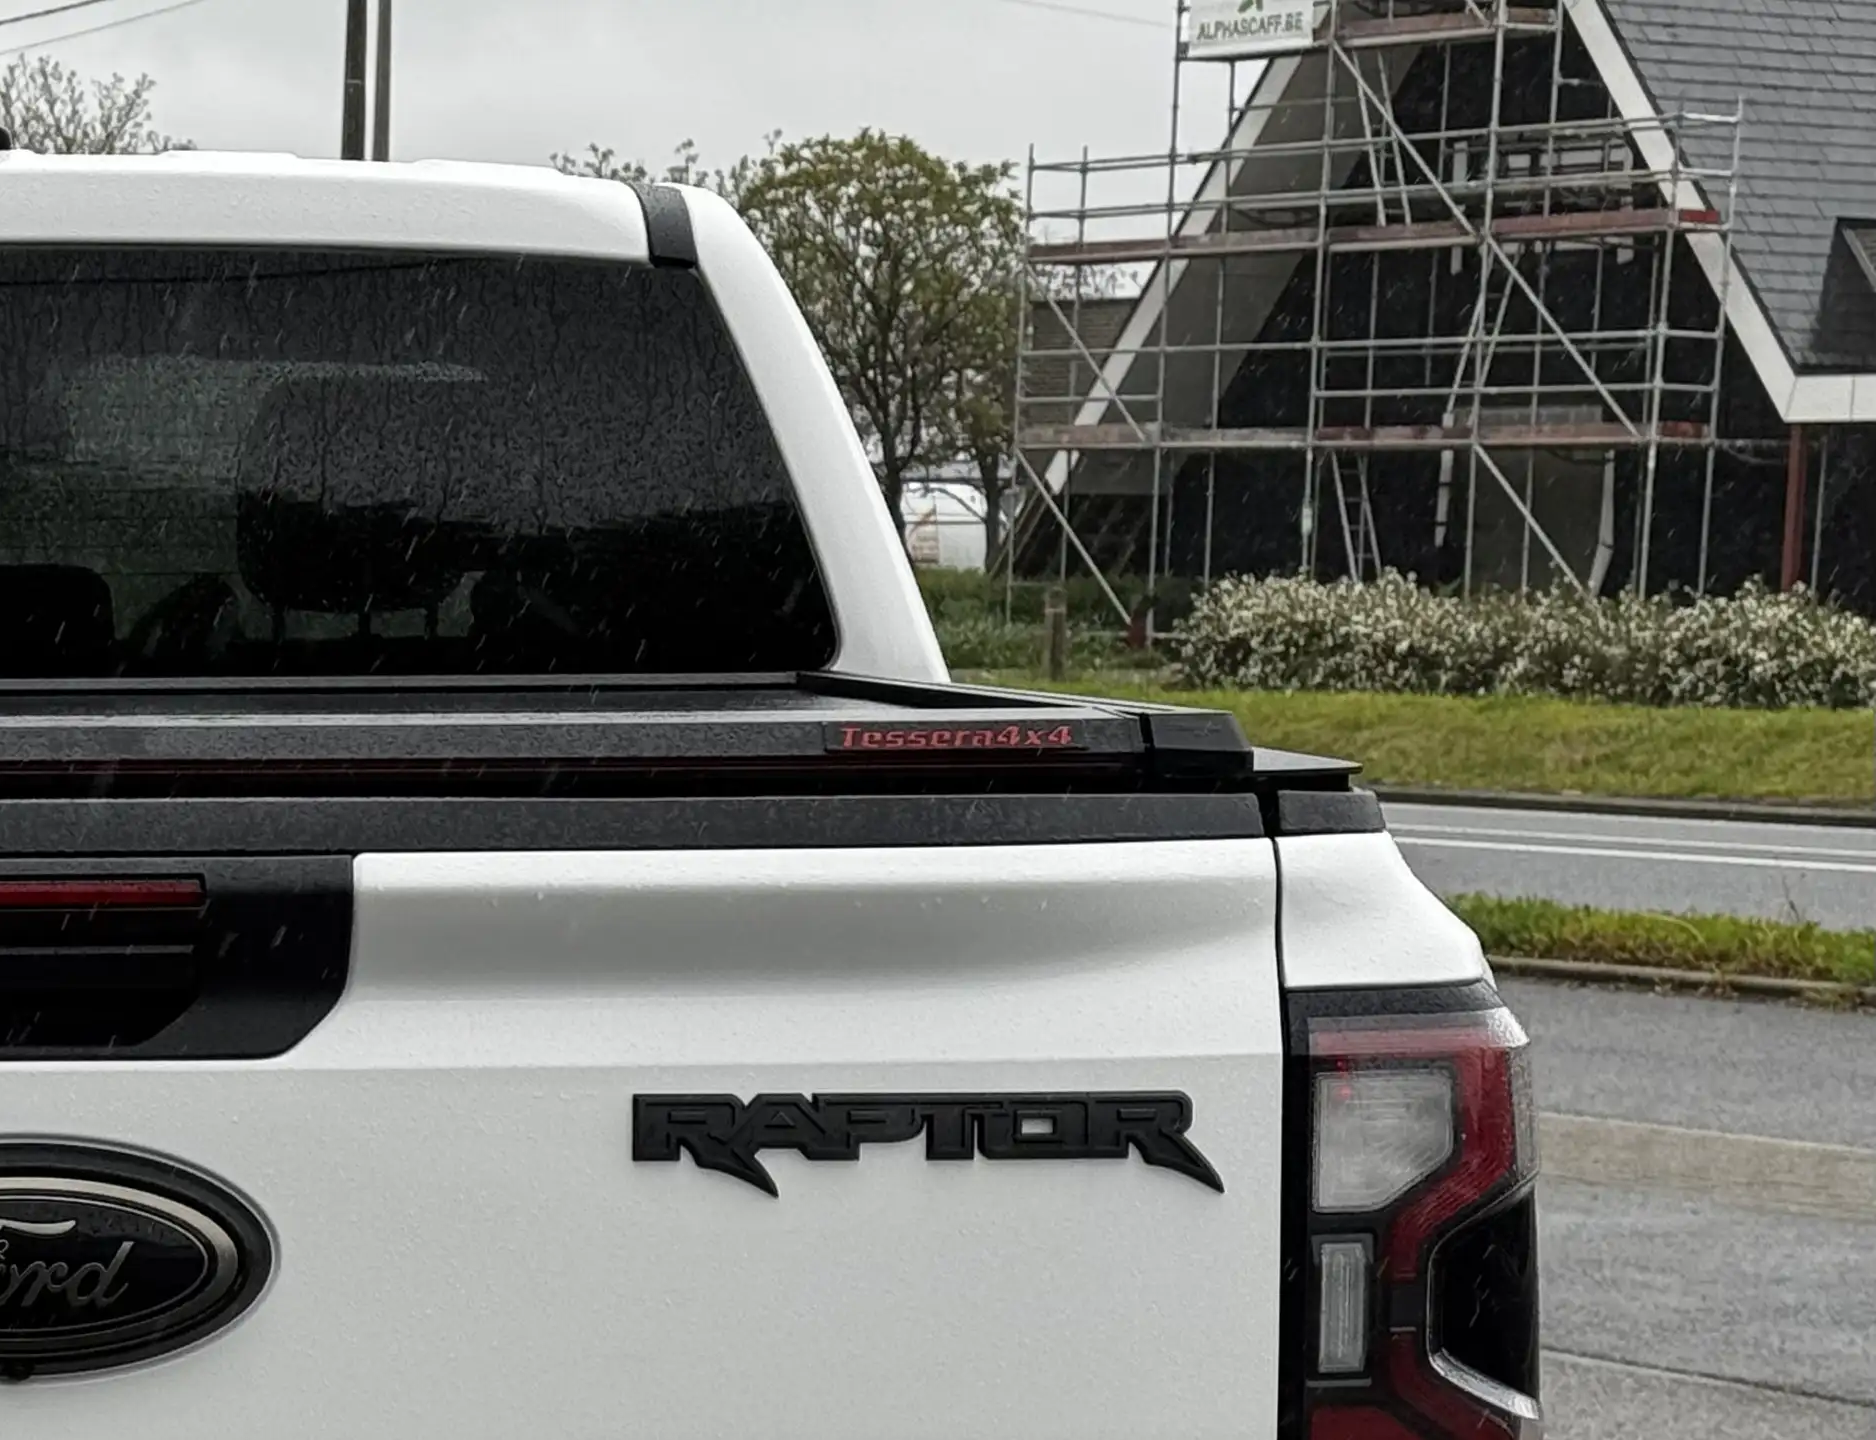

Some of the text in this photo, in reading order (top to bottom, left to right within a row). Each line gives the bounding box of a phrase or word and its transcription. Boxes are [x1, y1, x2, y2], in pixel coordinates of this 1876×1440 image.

[1196, 11, 1304, 40] ALPHASCAFF.BE
[840, 725, 1072, 748] Tessera4x4
[632, 1091, 1224, 1198] RAPTOR
